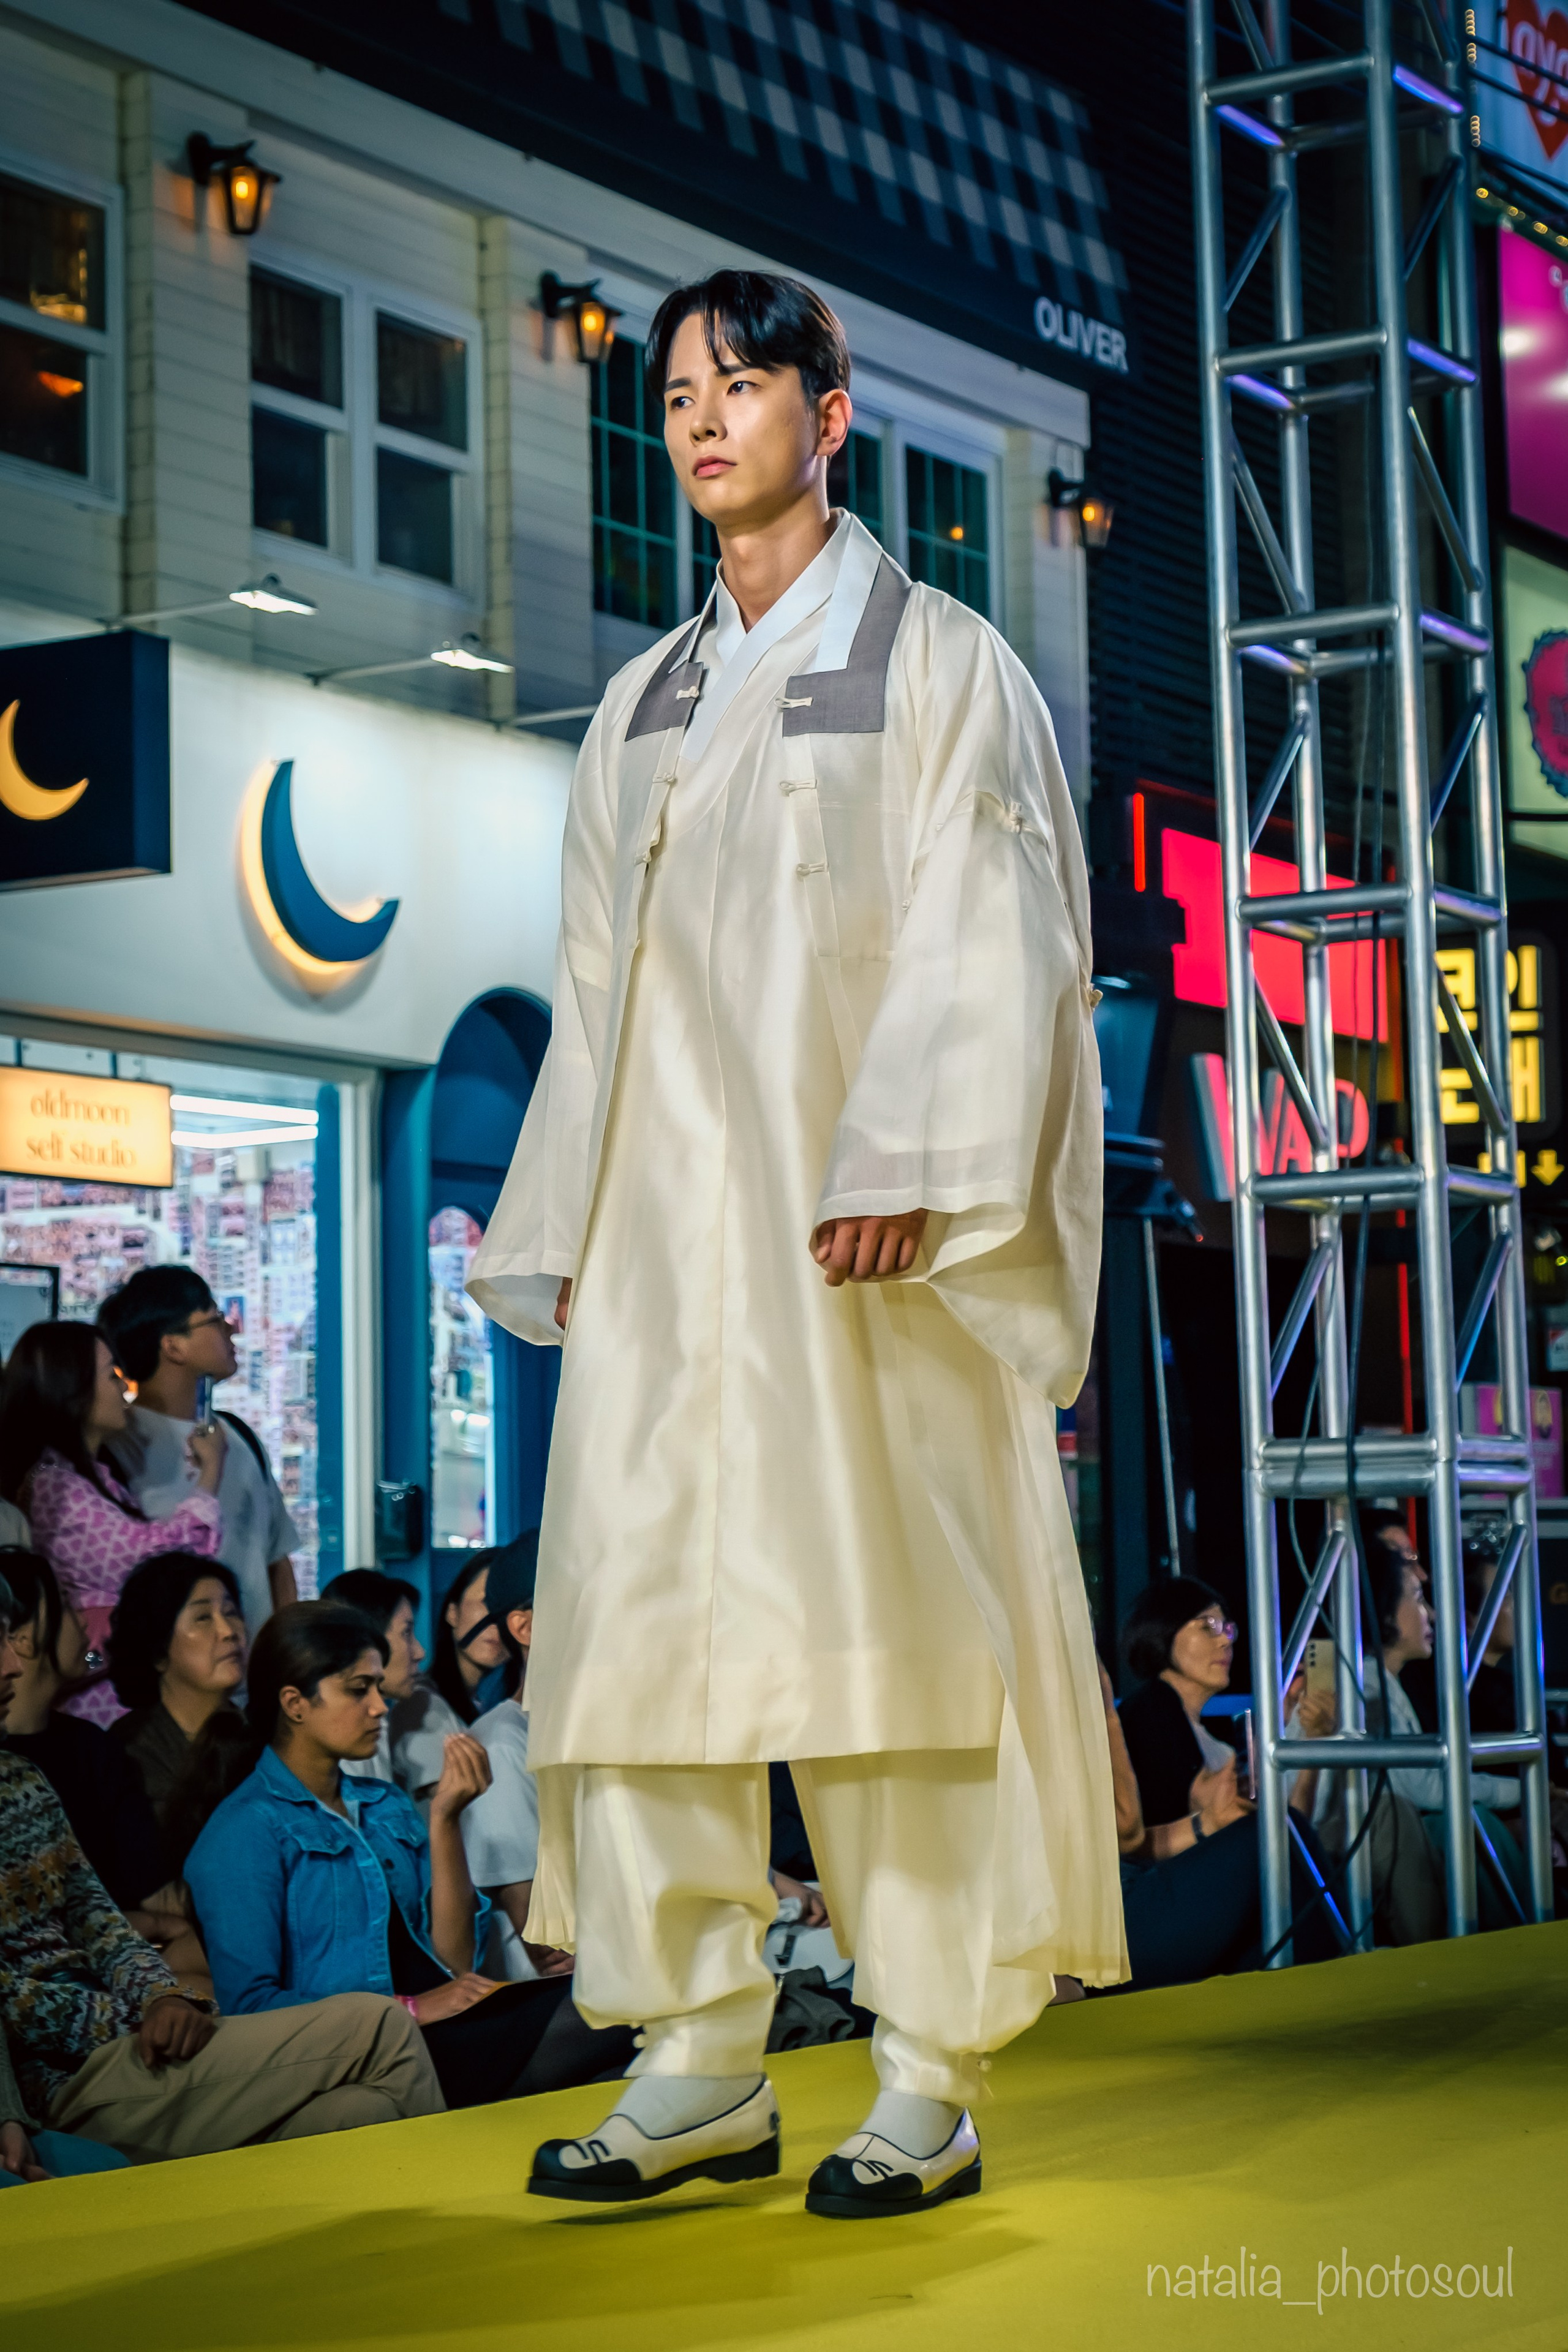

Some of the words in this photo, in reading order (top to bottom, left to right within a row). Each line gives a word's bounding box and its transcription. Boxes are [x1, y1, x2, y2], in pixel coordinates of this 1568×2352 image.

[1034, 296, 1128, 374] OLIVER
[31, 1088, 131, 1127] oldmoon
[69, 1138, 137, 1168] studio
